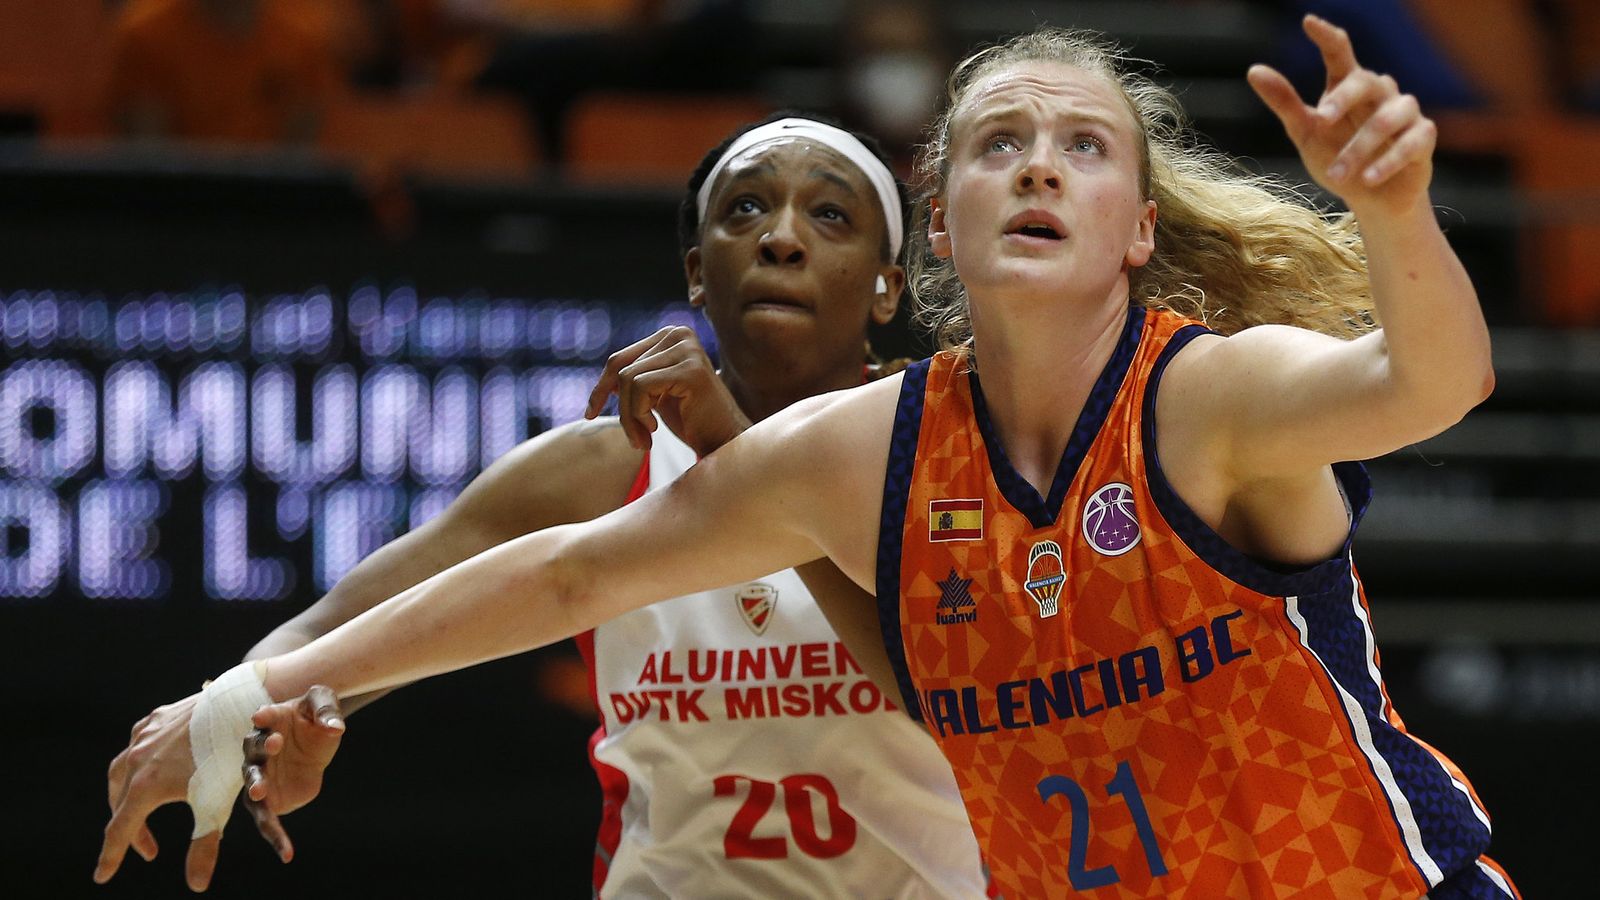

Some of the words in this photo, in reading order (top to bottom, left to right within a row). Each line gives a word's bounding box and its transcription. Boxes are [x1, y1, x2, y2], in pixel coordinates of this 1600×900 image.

[936, 608, 977, 625] luanvi
[724, 680, 898, 721] MISKO
[915, 645, 1166, 738] VALENCIA
[1174, 609, 1252, 684] BC
[712, 773, 857, 860] 20
[1036, 760, 1169, 892] 21
